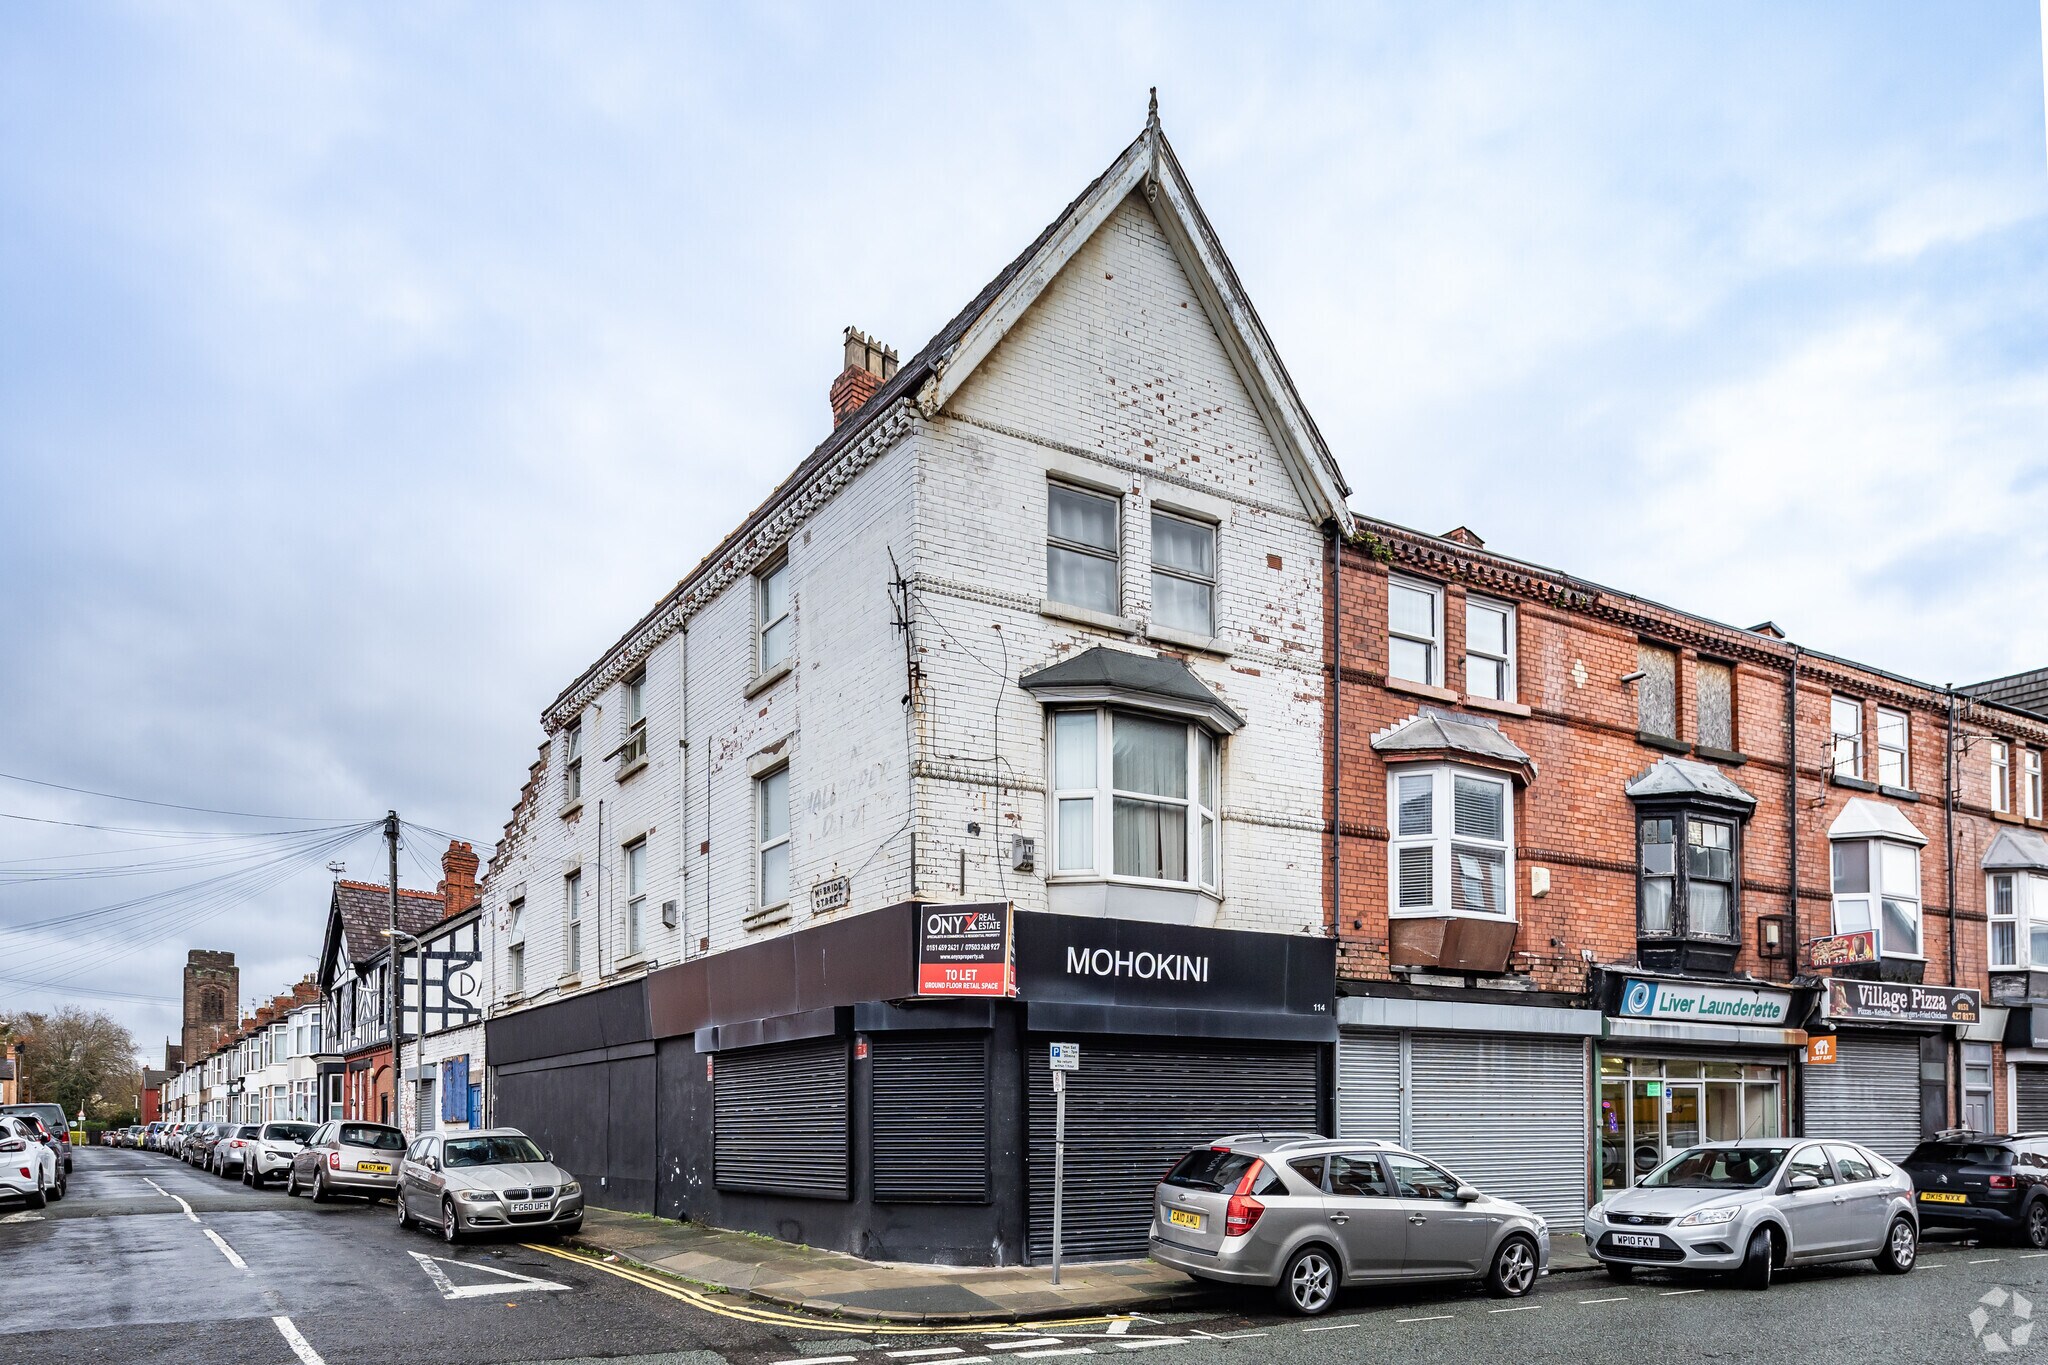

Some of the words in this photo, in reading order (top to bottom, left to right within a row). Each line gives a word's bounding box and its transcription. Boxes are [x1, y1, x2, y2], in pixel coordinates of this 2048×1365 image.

[816, 893, 842, 908] STREET
[978, 913, 996, 921] REAL
[927, 912, 979, 935] ONYX
[978, 922, 1001, 930] ESTATE
[1067, 946, 1209, 983] MOHOKINI
[1814, 958, 1832, 966] 0151
[1834, 956, 1848, 964] 427
[946, 970, 958, 980] TO
[960, 970, 978, 980] LET
[1858, 985, 1908, 1013] Village
[1912, 988, 1947, 1010] Pizza
[1314, 1004, 1326, 1012] 114
[1659, 992, 1695, 1012] Liver
[1698, 995, 1781, 1018] Launderette
[1858, 1008, 1872, 1016] Pizzas
[1931, 1012, 1948, 1020] Chicken
[513, 1203, 533, 1211] FG60
[1618, 1236, 1635, 1245] WP10
[1638, 1237, 1653, 1246] FKY
